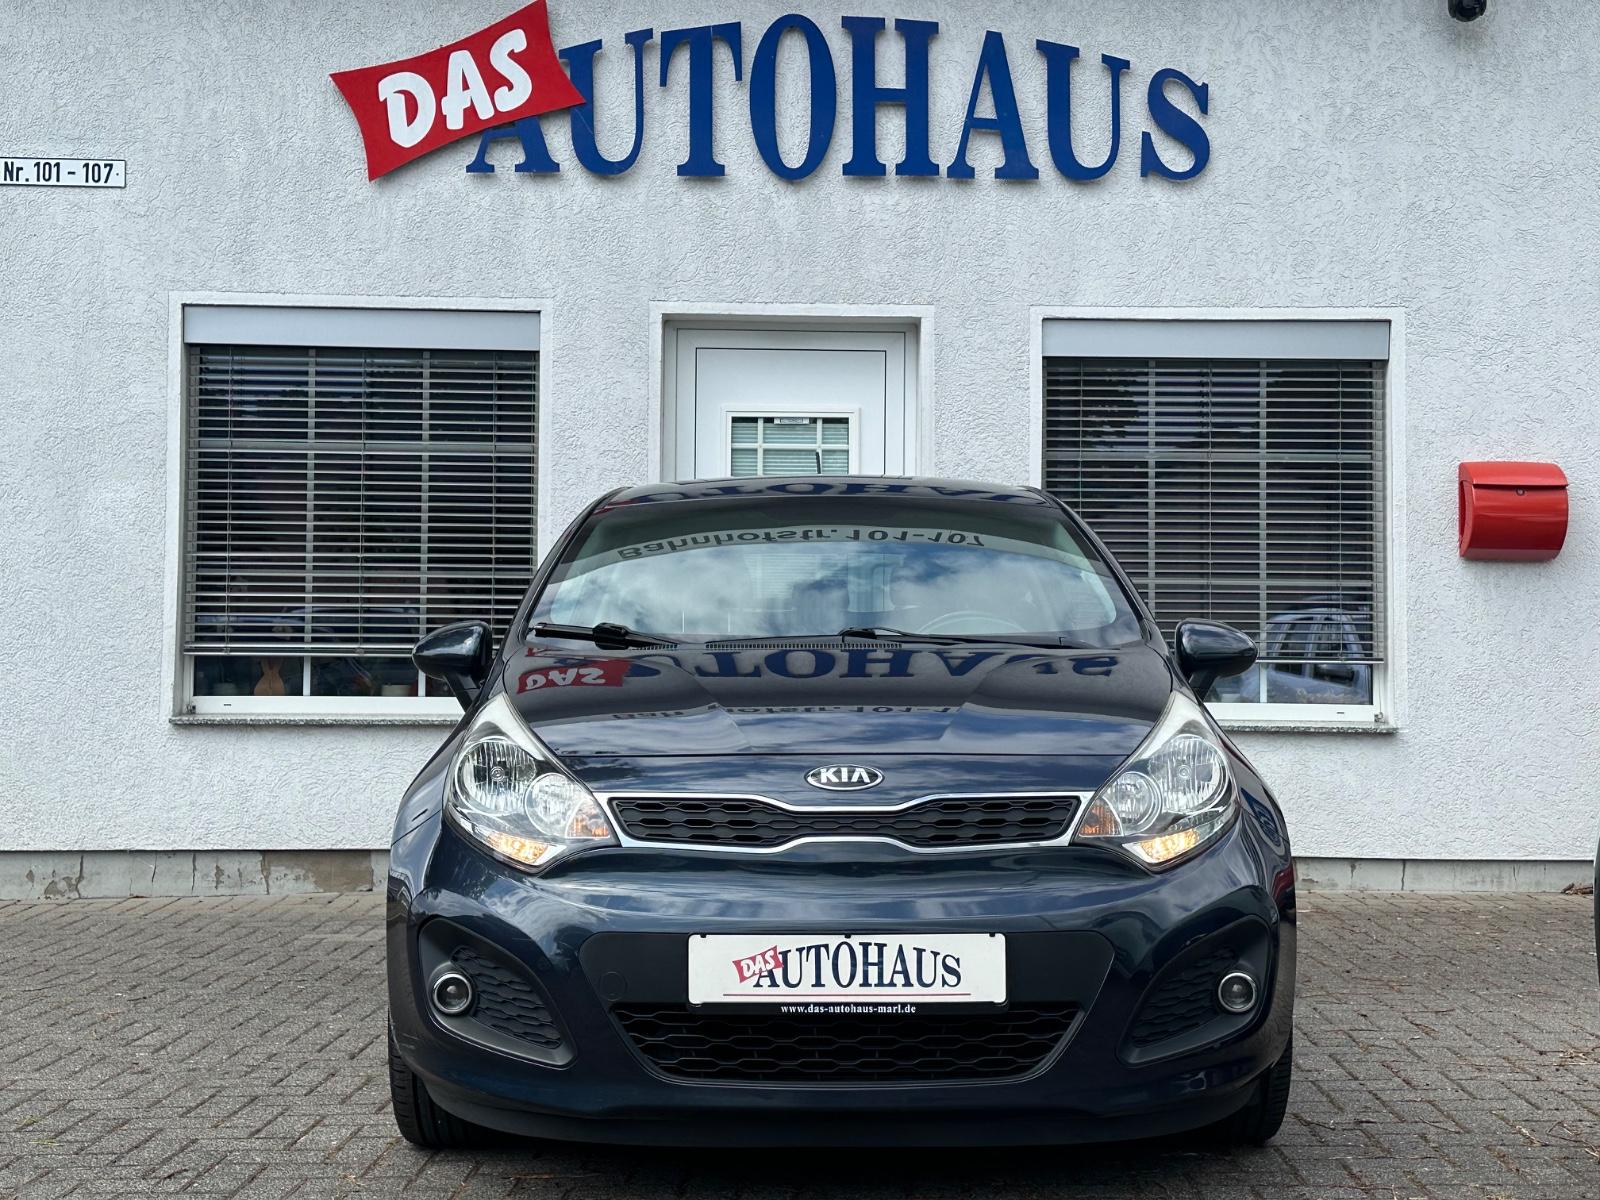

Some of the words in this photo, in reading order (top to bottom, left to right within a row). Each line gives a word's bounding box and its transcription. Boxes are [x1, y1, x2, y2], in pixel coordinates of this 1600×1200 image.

[378, 28, 533, 148] DAS
[465, 13, 1210, 181] AUTOHAUS
[3, 161, 30, 182] Nr.
[820, 767, 871, 783] KIA
[740, 949, 776, 978] DAS
[752, 941, 962, 989] AUTOHAUS
[780, 1003, 917, 1014] www.das-autohaus-marl.de
